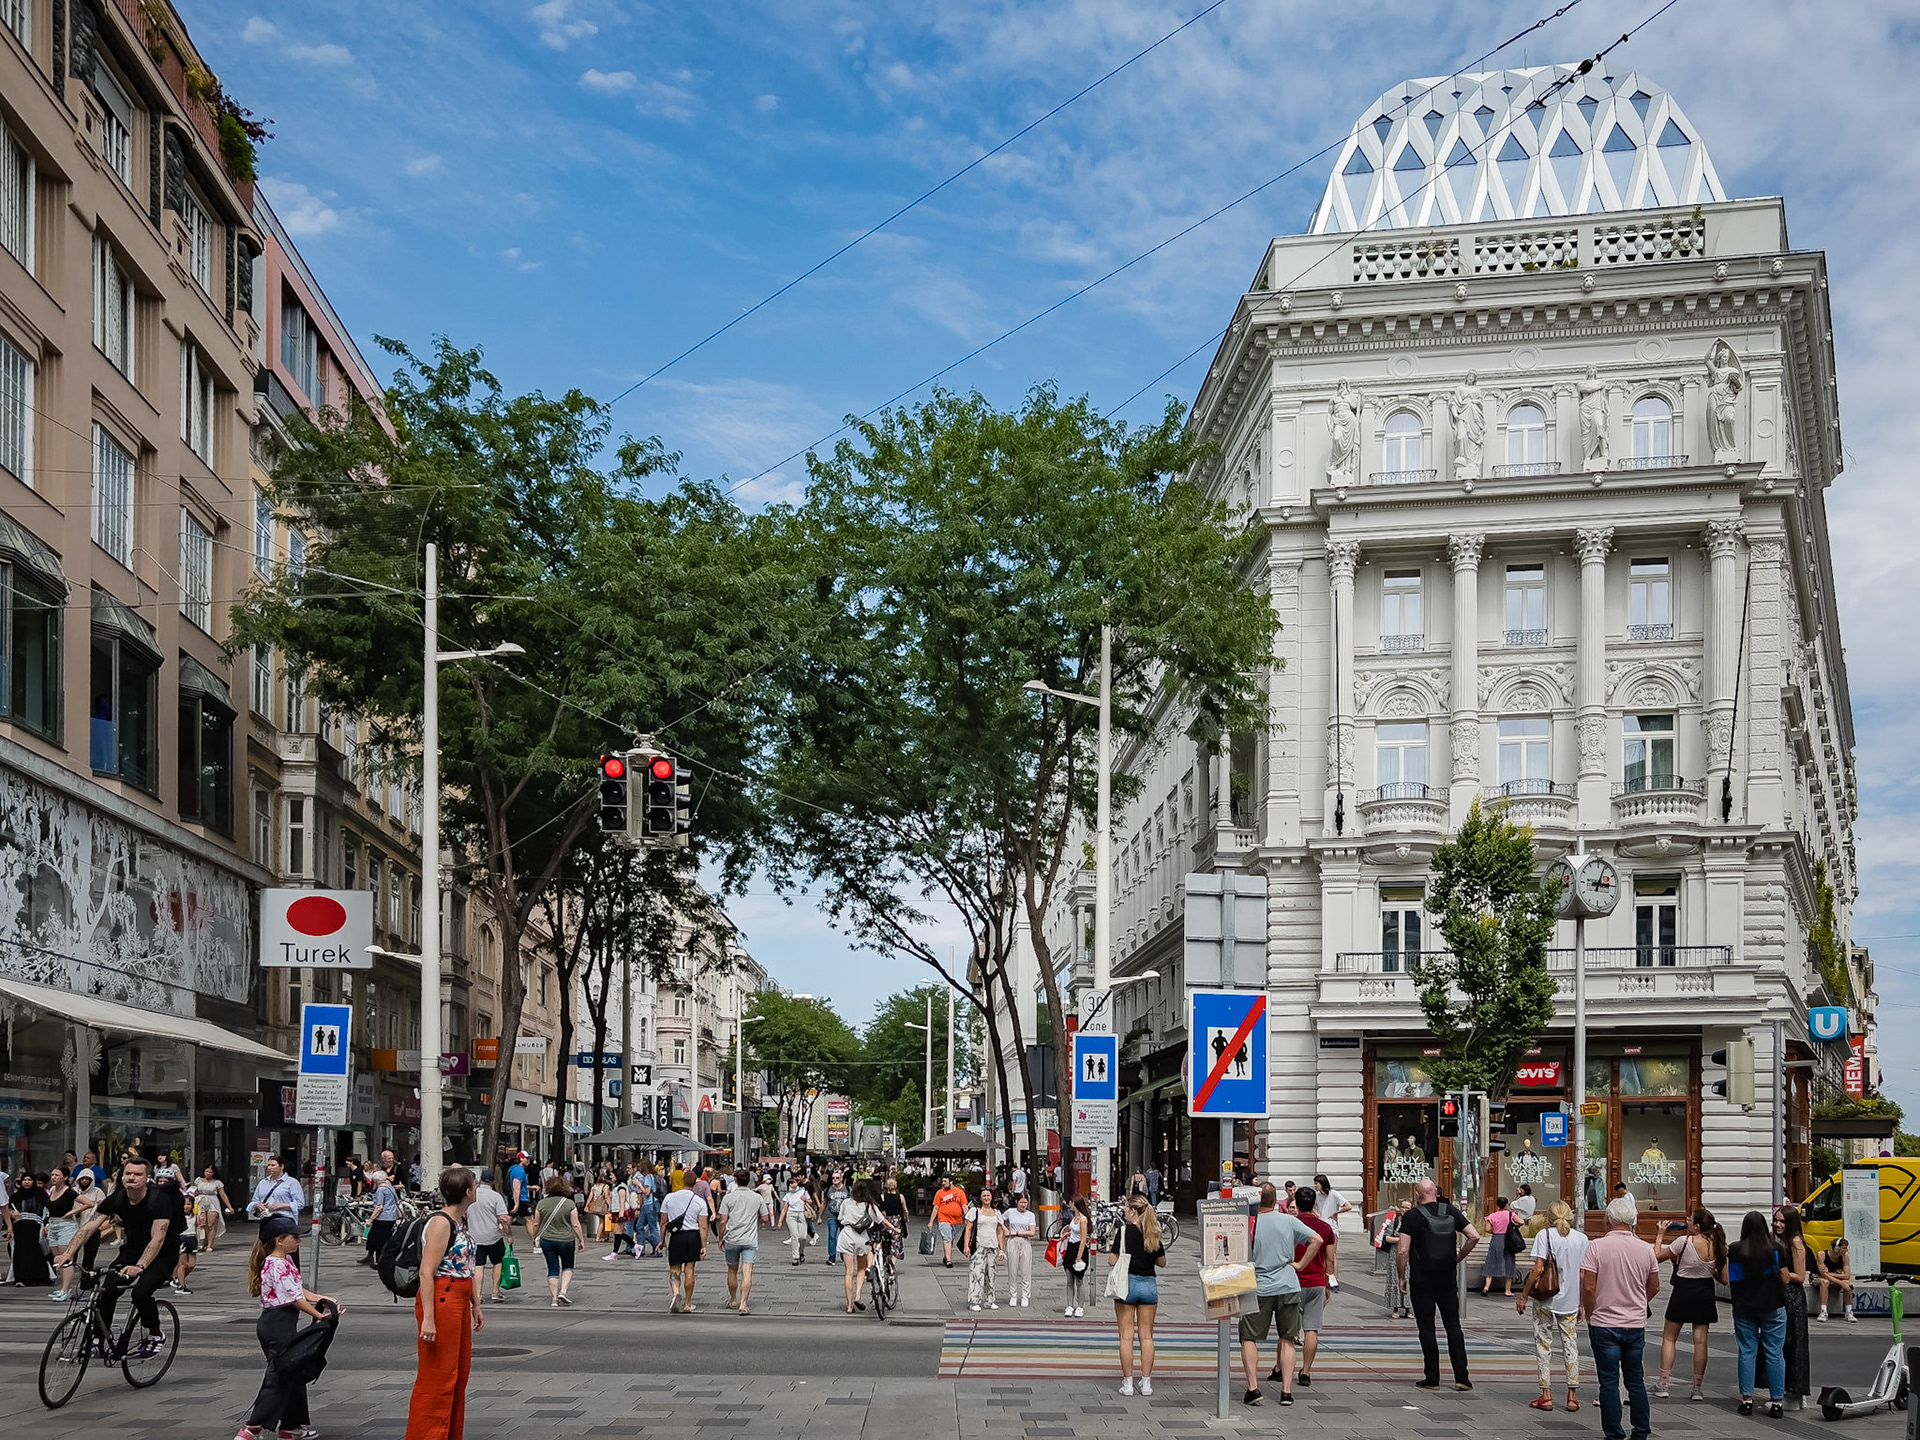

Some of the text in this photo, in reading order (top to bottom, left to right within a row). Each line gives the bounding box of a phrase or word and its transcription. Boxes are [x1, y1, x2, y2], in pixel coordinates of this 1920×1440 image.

[279, 942, 351, 963] Turek
[1088, 996, 1104, 1012] 30
[1815, 1013, 1839, 1036] U
[583, 1056, 616, 1064] DOLAS
[1846, 1045, 1861, 1092] HEMA
[659, 1095, 668, 1127] ors
[1546, 1120, 1563, 1130] Taxi
[1075, 1150, 1091, 1162] JET
[1396, 1156, 1420, 1164] BUY
[1384, 1162, 1433, 1170] BETTER.
[1628, 1162, 1679, 1170] BETTER.
[1390, 1169, 1426, 1177] WEAR
[1509, 1169, 1550, 1177] WASTE
[1634, 1169, 1672, 1177] WEAR
[1627, 1176, 1680, 1184] LONGER.
